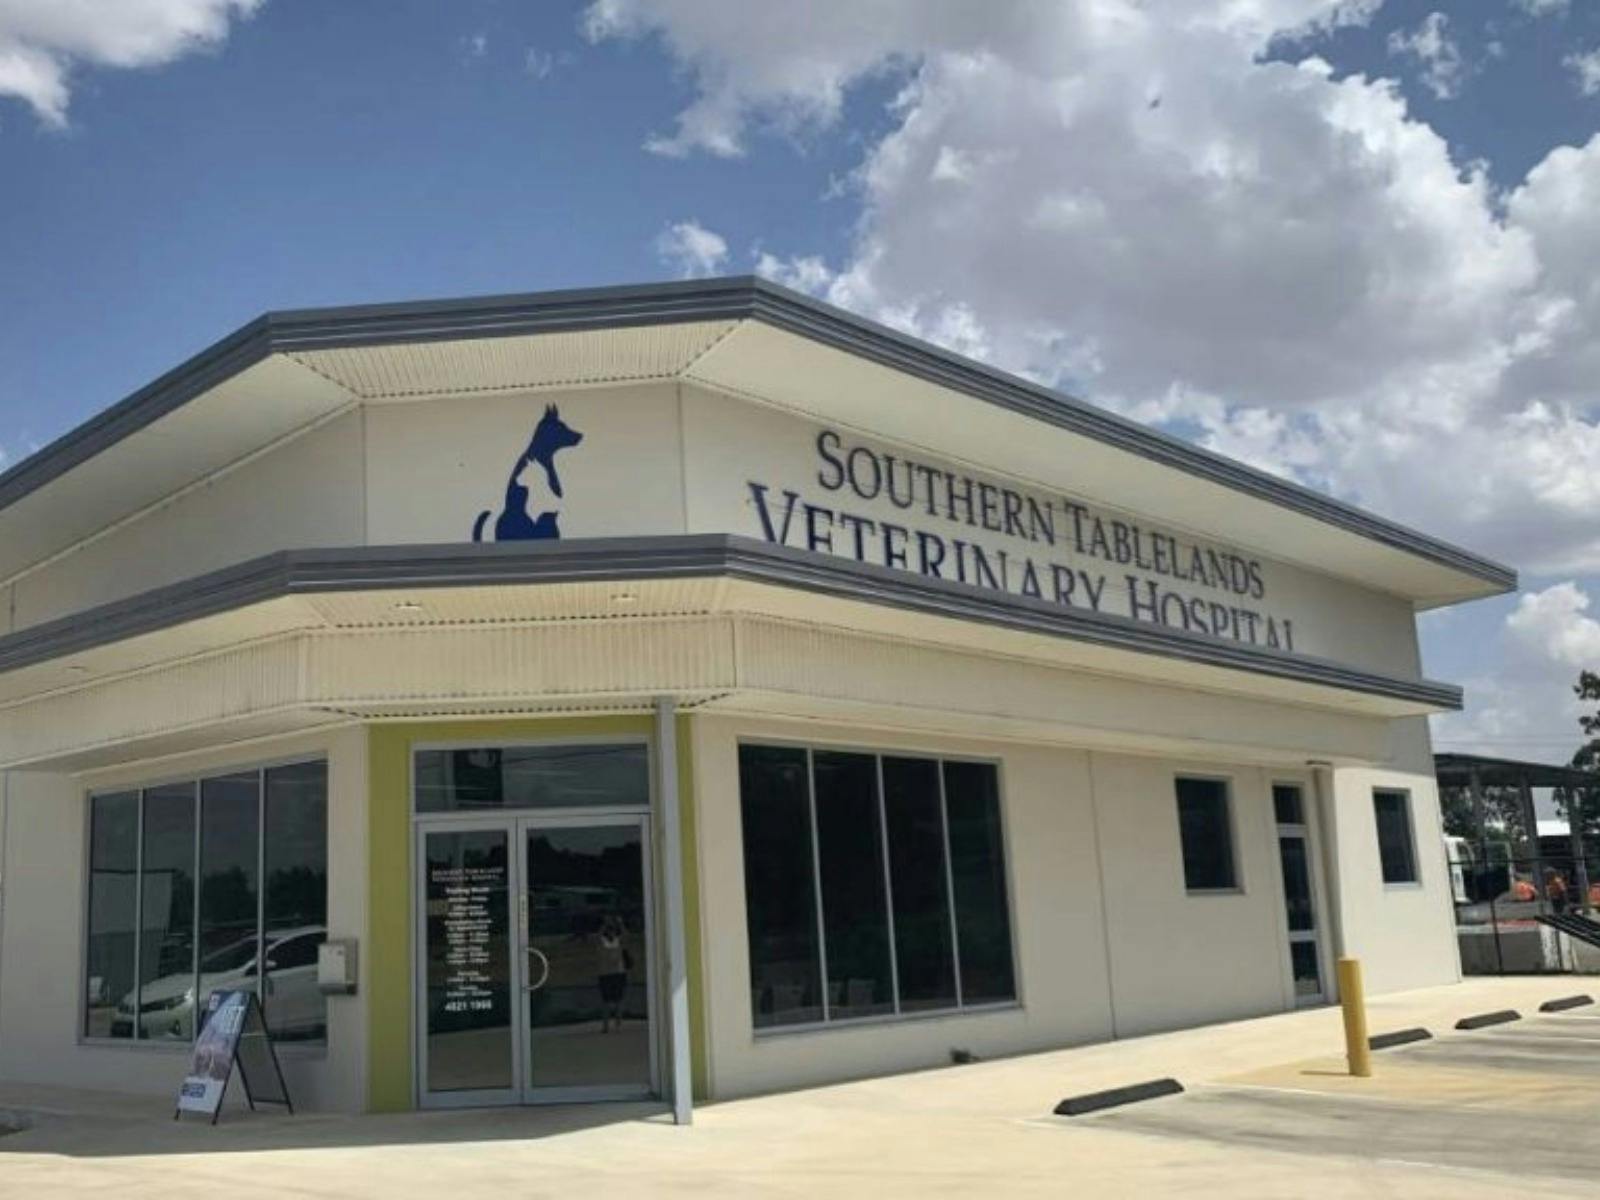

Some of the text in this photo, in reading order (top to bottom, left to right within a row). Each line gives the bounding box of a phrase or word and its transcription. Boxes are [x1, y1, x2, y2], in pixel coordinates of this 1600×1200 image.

[747, 482, 1106, 611] VETERINARY
[816, 430, 1265, 598] SOUTHERN TABLELANDS
